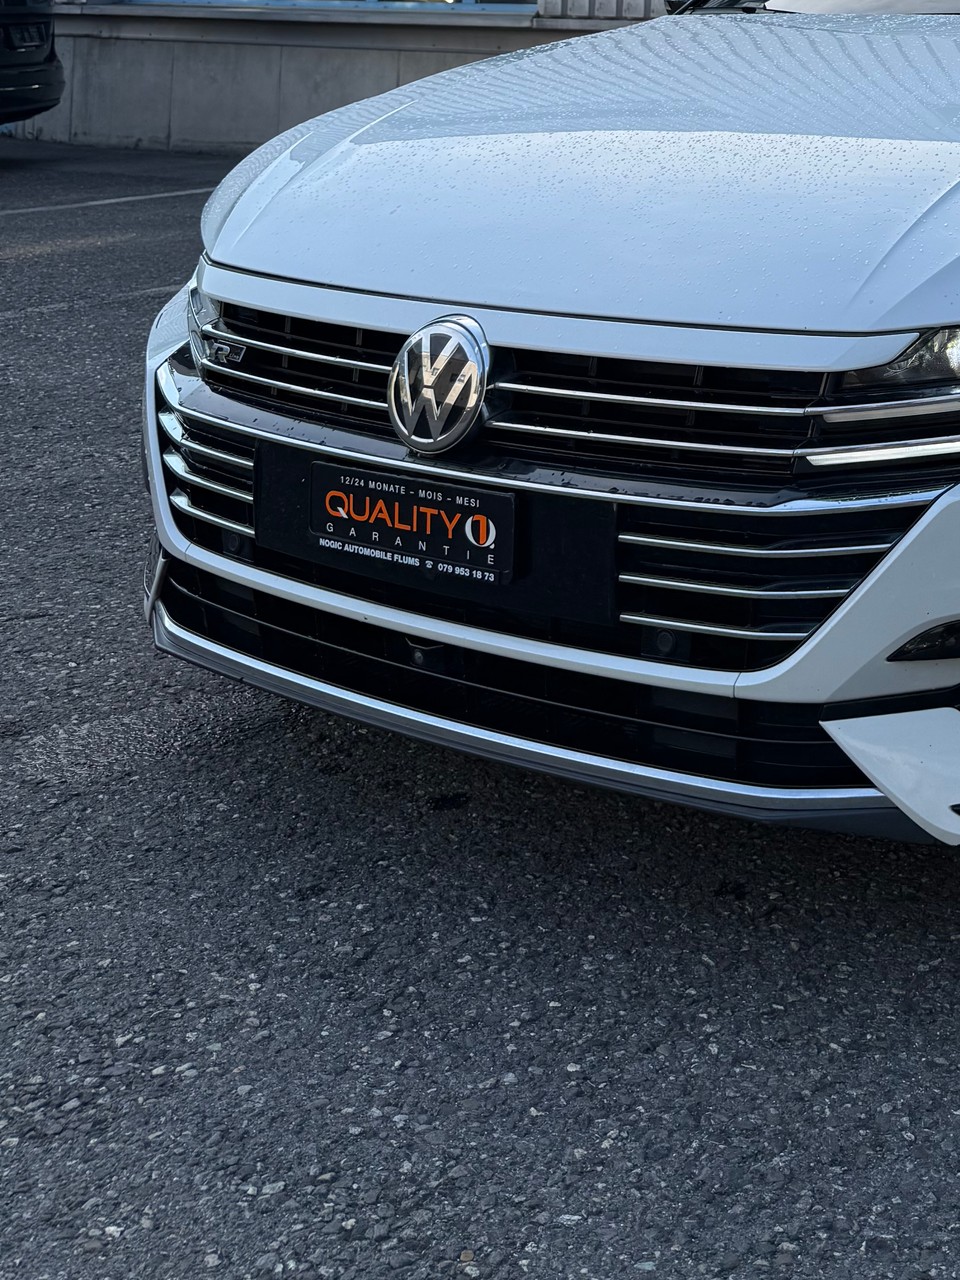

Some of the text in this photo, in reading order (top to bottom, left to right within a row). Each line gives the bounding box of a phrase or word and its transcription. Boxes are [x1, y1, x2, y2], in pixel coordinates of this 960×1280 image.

[340, 476, 365, 487] 12/24
[368, 480, 406, 495] MONATE
[418, 489, 443, 501] MOIS
[456, 495, 480, 508] MESI
[325, 490, 462, 539] QUALITY
[319, 538, 495, 582] NOGIC AUTOMOBILE FLUMS 079 953 18 73
[326, 522, 495, 565] GARANTIE
